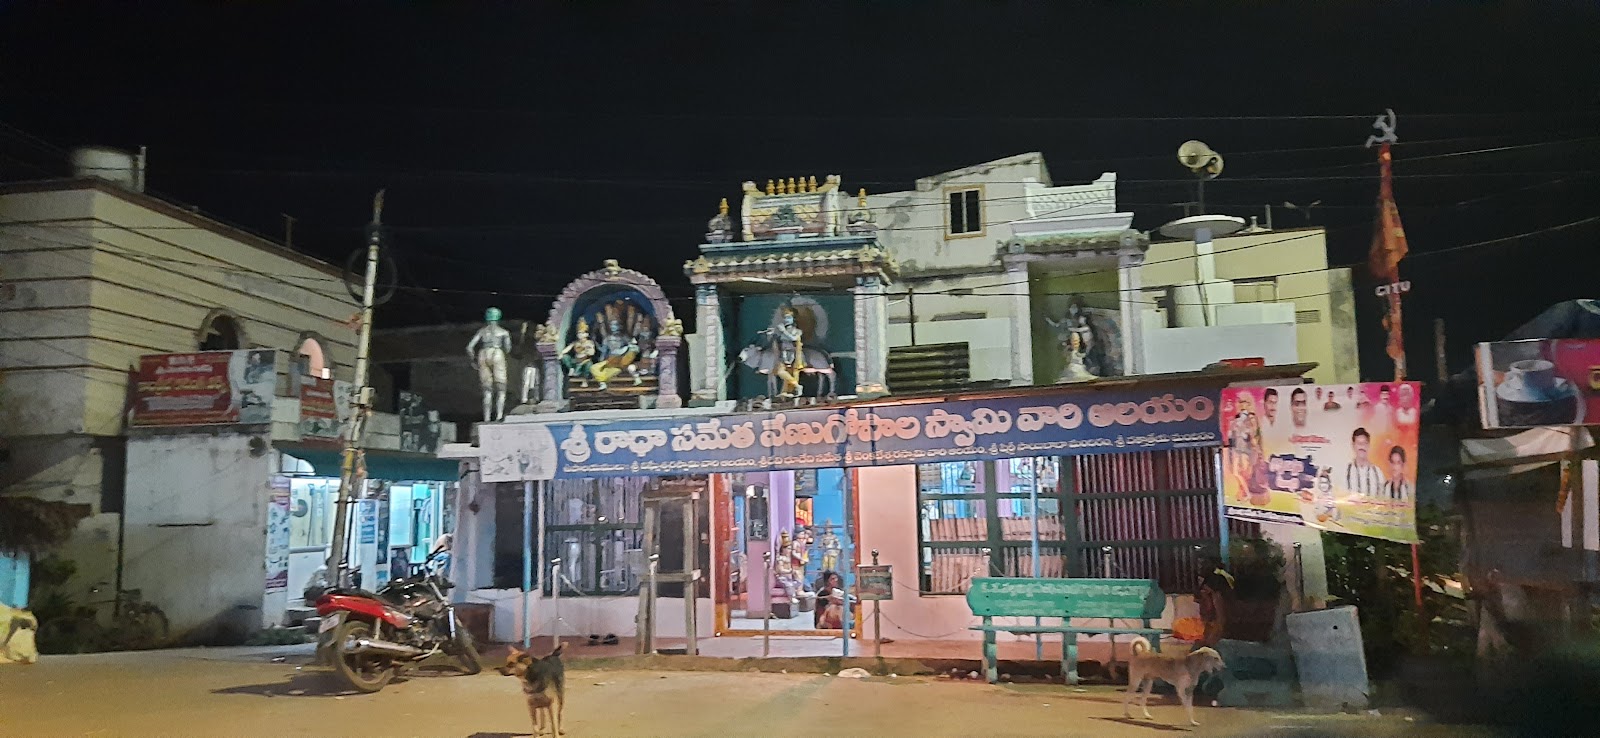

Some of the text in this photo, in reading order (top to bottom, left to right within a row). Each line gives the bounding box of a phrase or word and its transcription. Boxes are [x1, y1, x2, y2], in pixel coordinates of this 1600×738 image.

[1375, 280, 1411, 297] CITU
[561, 423, 592, 463] శ్రీ
[594, 428, 667, 458] రాధా
[671, 417, 756, 453] సమేత
[760, 408, 920, 447] వేణుగోపాల
[925, 407, 1012, 446] స్వామి
[1016, 403, 1083, 431] వారి
[630, 460, 640, 473] శ్రీ
[700, 460, 720, 468] వారి
[844, 450, 853, 464] శ్రీ
[926, 448, 947, 457] వారి
[988, 442, 999, 456] శ్రీ
[1114, 434, 1126, 448] శ్రీ
